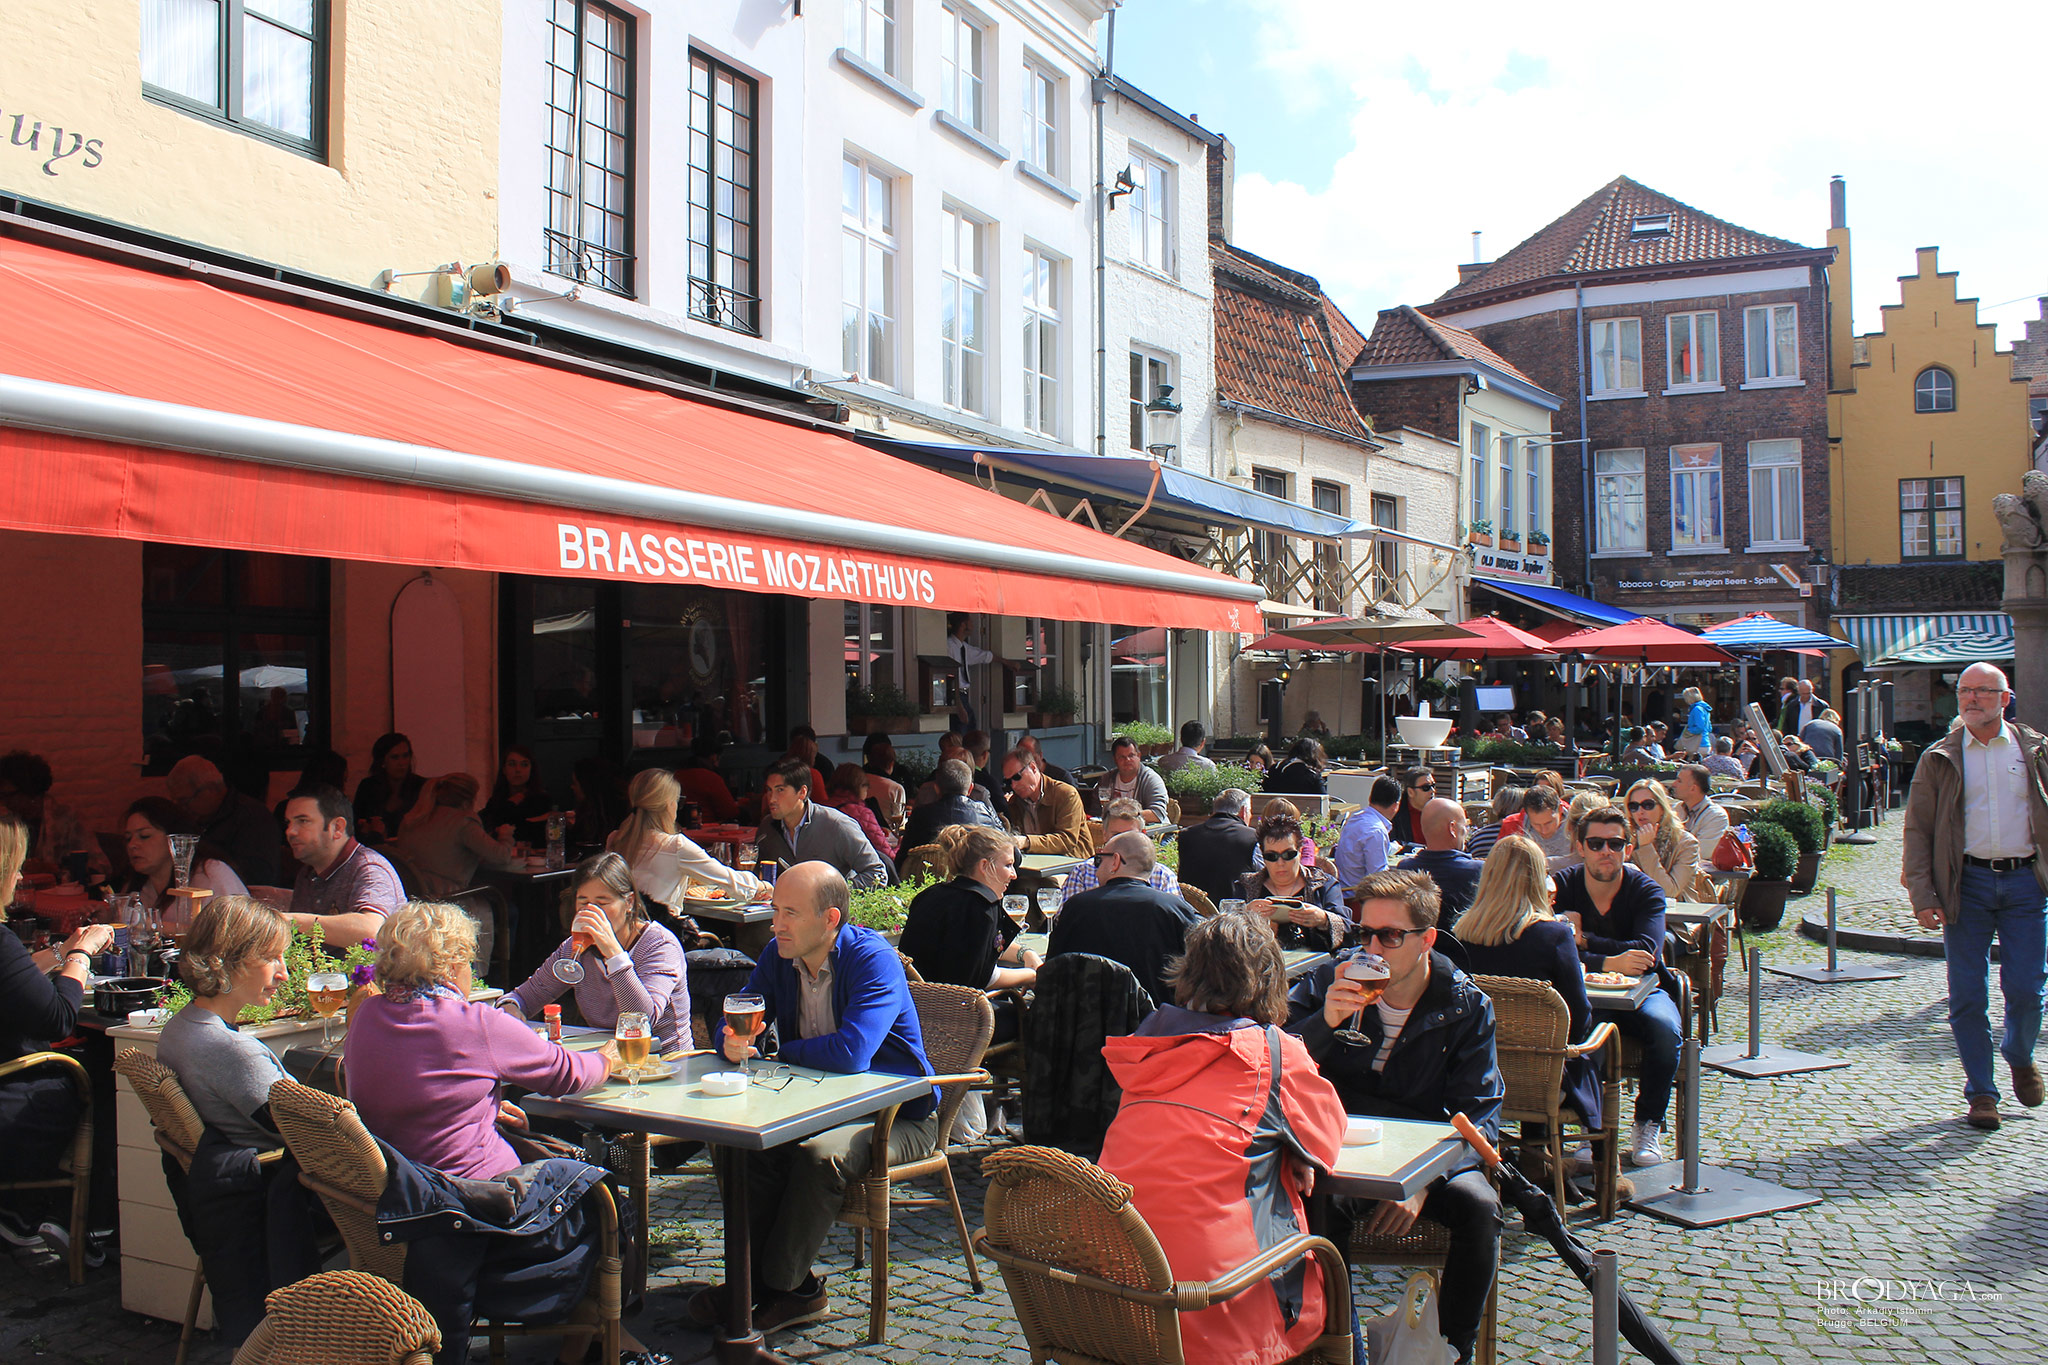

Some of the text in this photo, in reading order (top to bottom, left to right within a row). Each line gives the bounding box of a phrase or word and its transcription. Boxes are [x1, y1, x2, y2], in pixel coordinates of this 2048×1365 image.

[557, 523, 936, 604] BRASSERIE MOZARTHUYS
[1481, 555, 1494, 567] OLD
[1495, 557, 1519, 571] BRUGES
[1618, 580, 1653, 588] Tobacco
[1659, 579, 1686, 589] Cigars
[1692, 578, 1723, 588] Belgian
[1724, 577, 1747, 585] Beers
[1753, 576, 1778, 586] Spirits
